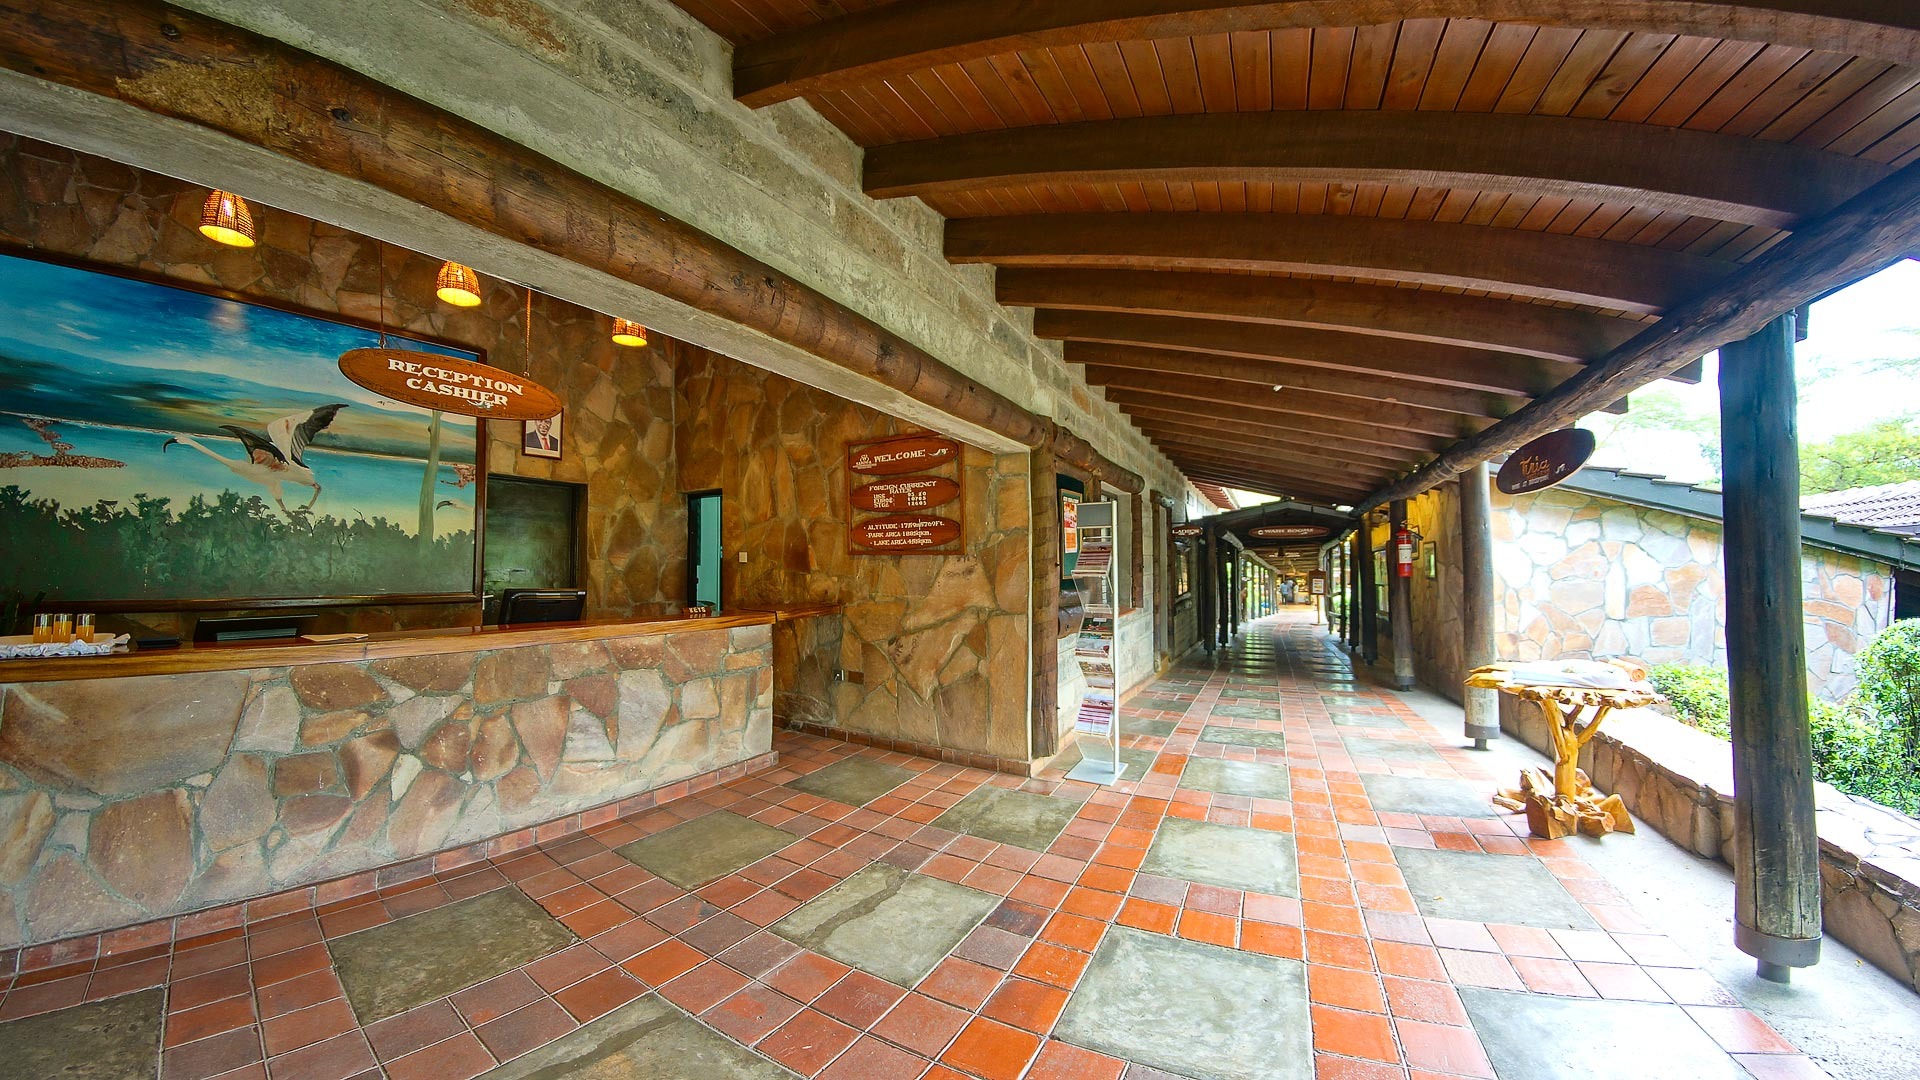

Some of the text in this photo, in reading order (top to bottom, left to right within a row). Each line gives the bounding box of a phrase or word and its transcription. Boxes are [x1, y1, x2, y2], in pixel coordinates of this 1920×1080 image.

[388, 358, 524, 396] RECEPTION
[406, 378, 508, 406] CASHIER
[874, 449, 926, 463] WELCOME
[869, 480, 937, 492] FOREIGN CURRENCY
